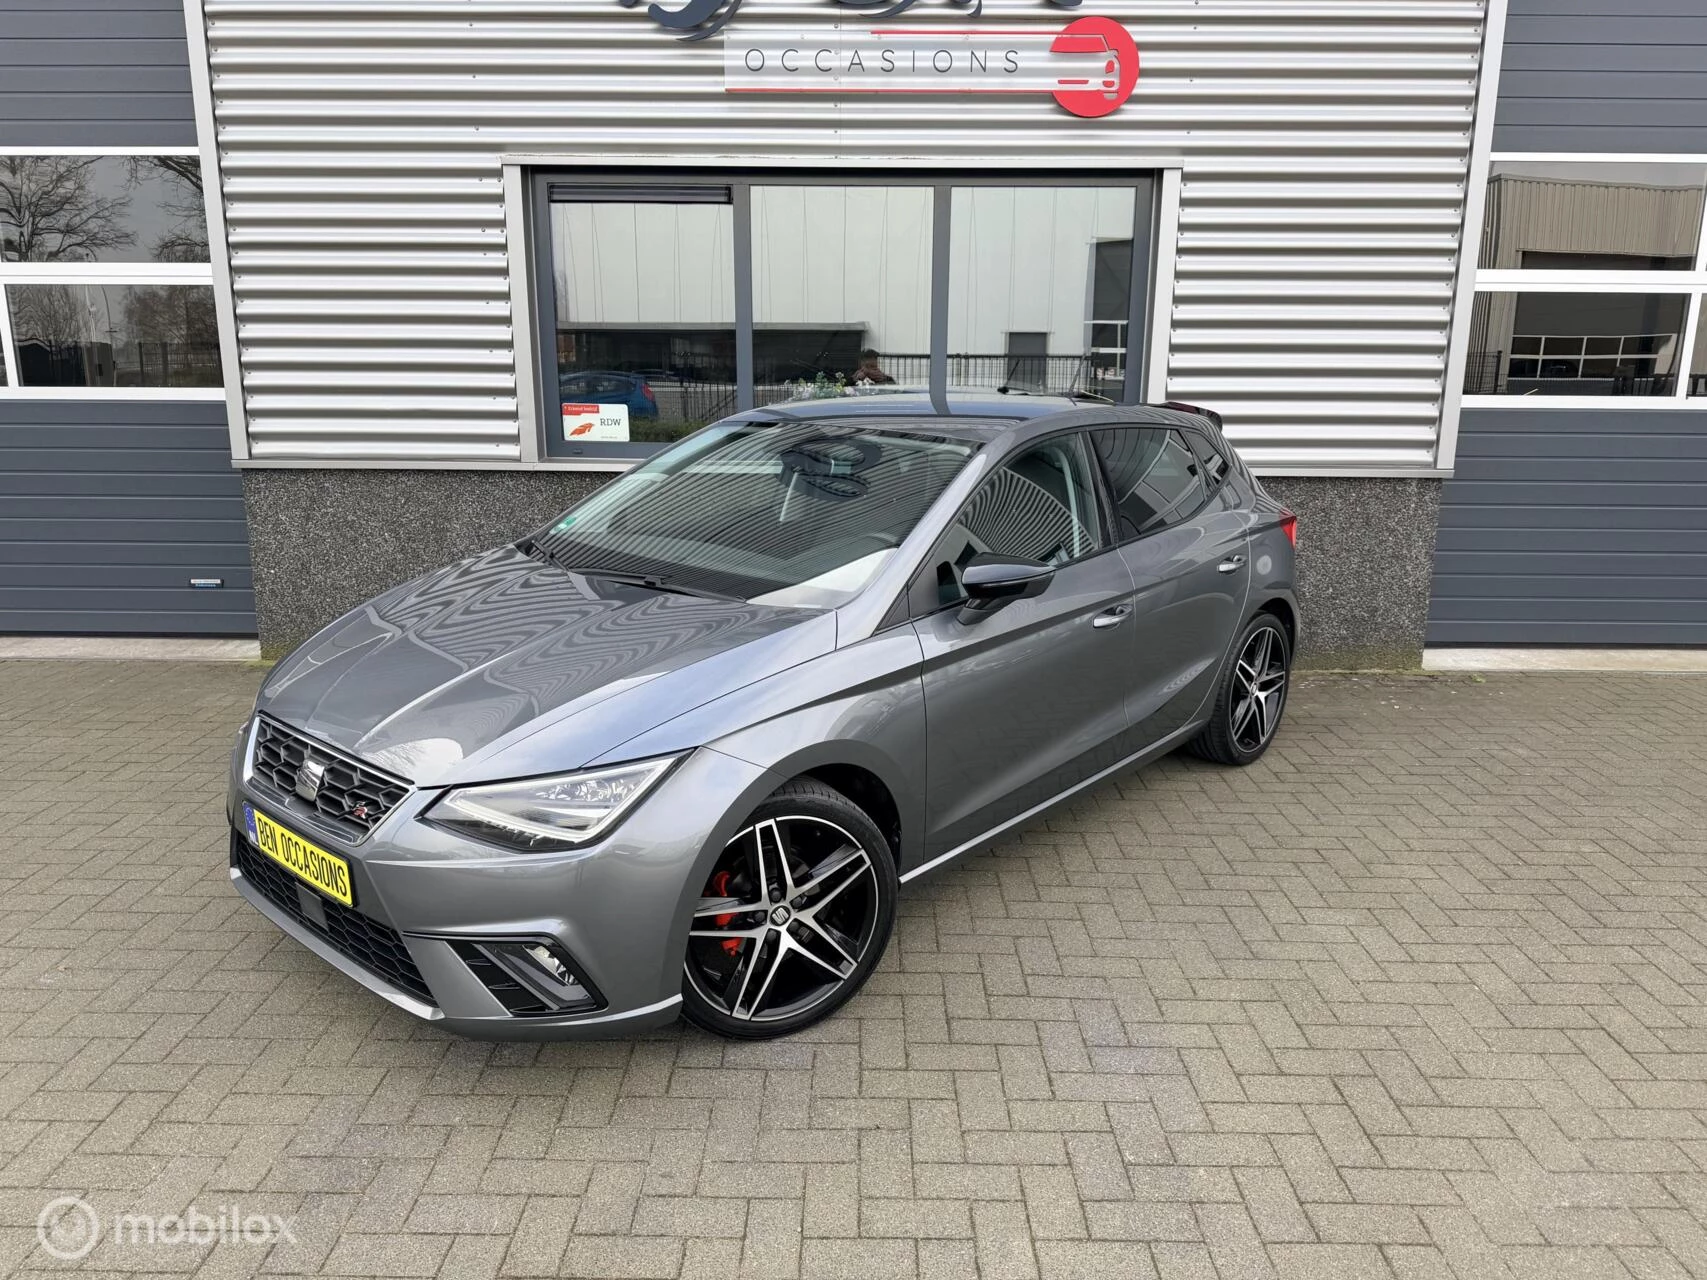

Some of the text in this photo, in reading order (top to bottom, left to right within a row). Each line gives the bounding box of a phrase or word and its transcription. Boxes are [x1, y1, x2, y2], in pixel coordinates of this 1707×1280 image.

[744, 48, 1020, 73] OCCASIONS
[600, 418, 621, 426] RDW
[248, 830, 259, 846] NL
[257, 817, 347, 897] BEN OCCASIONS
